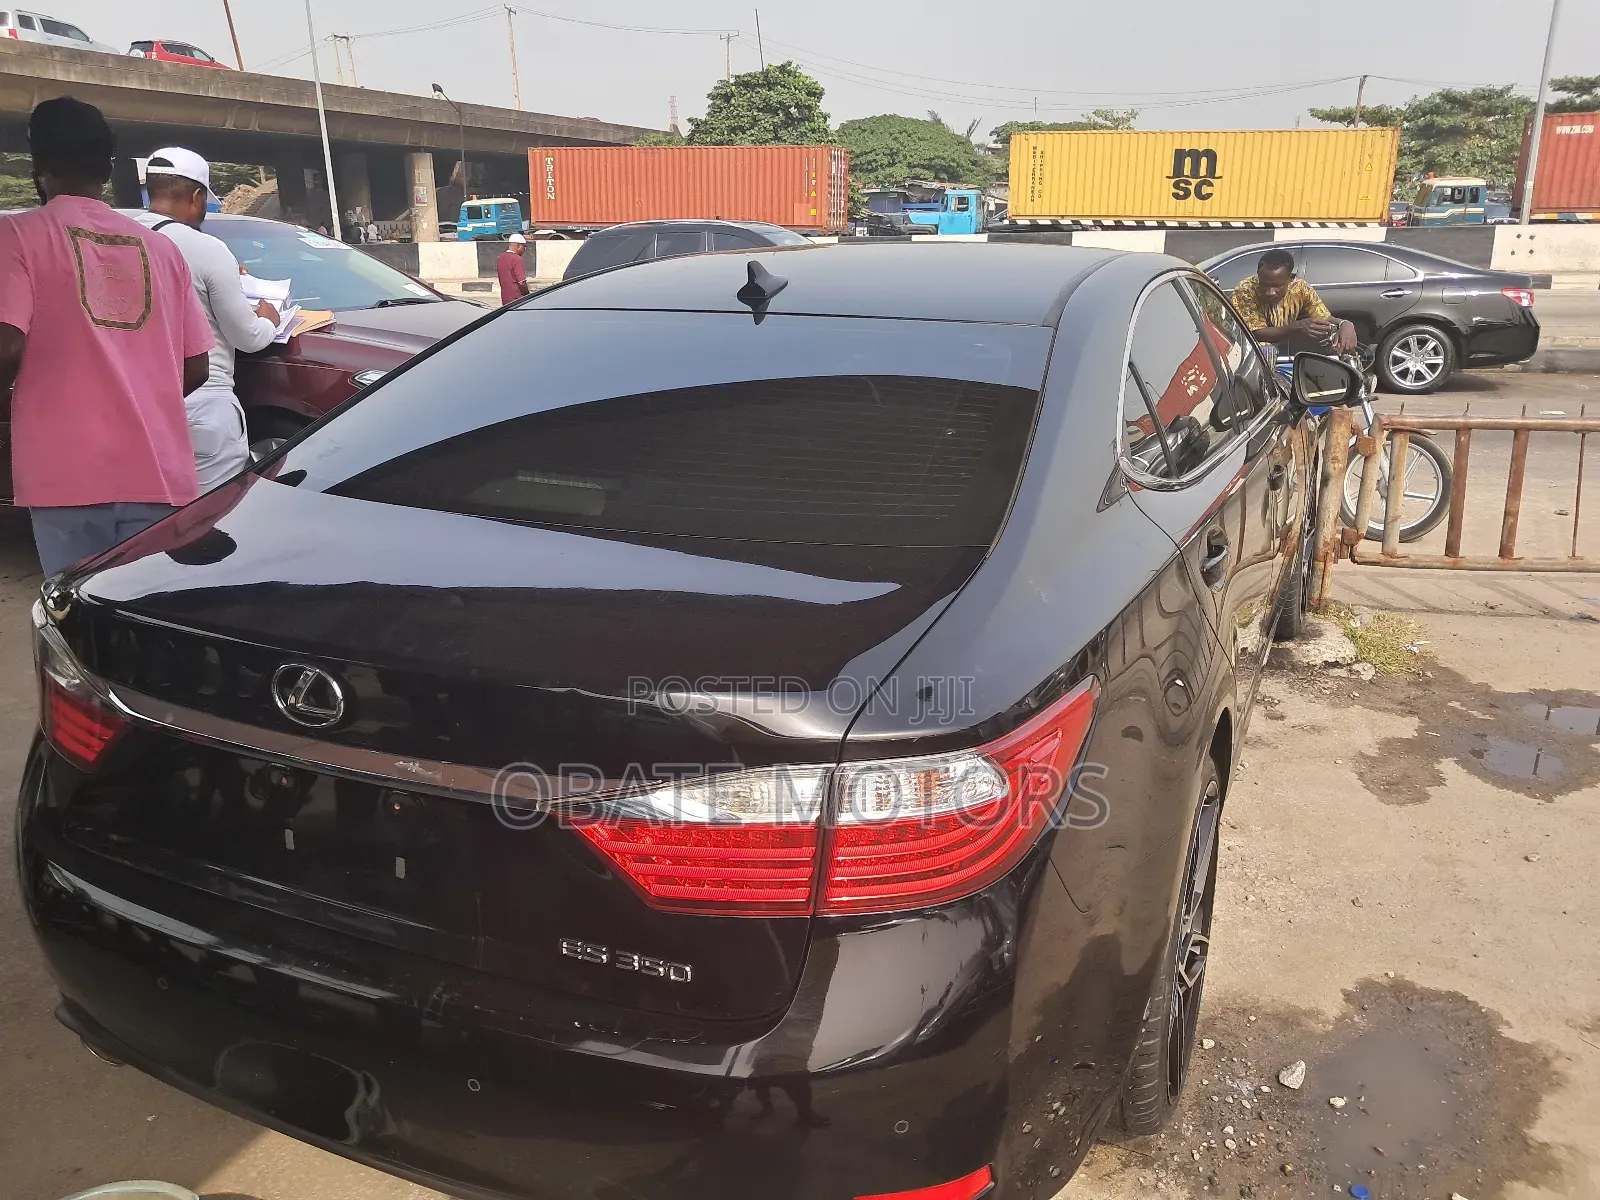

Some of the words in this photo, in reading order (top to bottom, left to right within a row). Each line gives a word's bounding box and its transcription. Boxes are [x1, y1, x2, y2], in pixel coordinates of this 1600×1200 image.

[545, 157, 556, 200] TRITON
[559, 937, 609, 964] ES
[615, 949, 694, 983] 350
